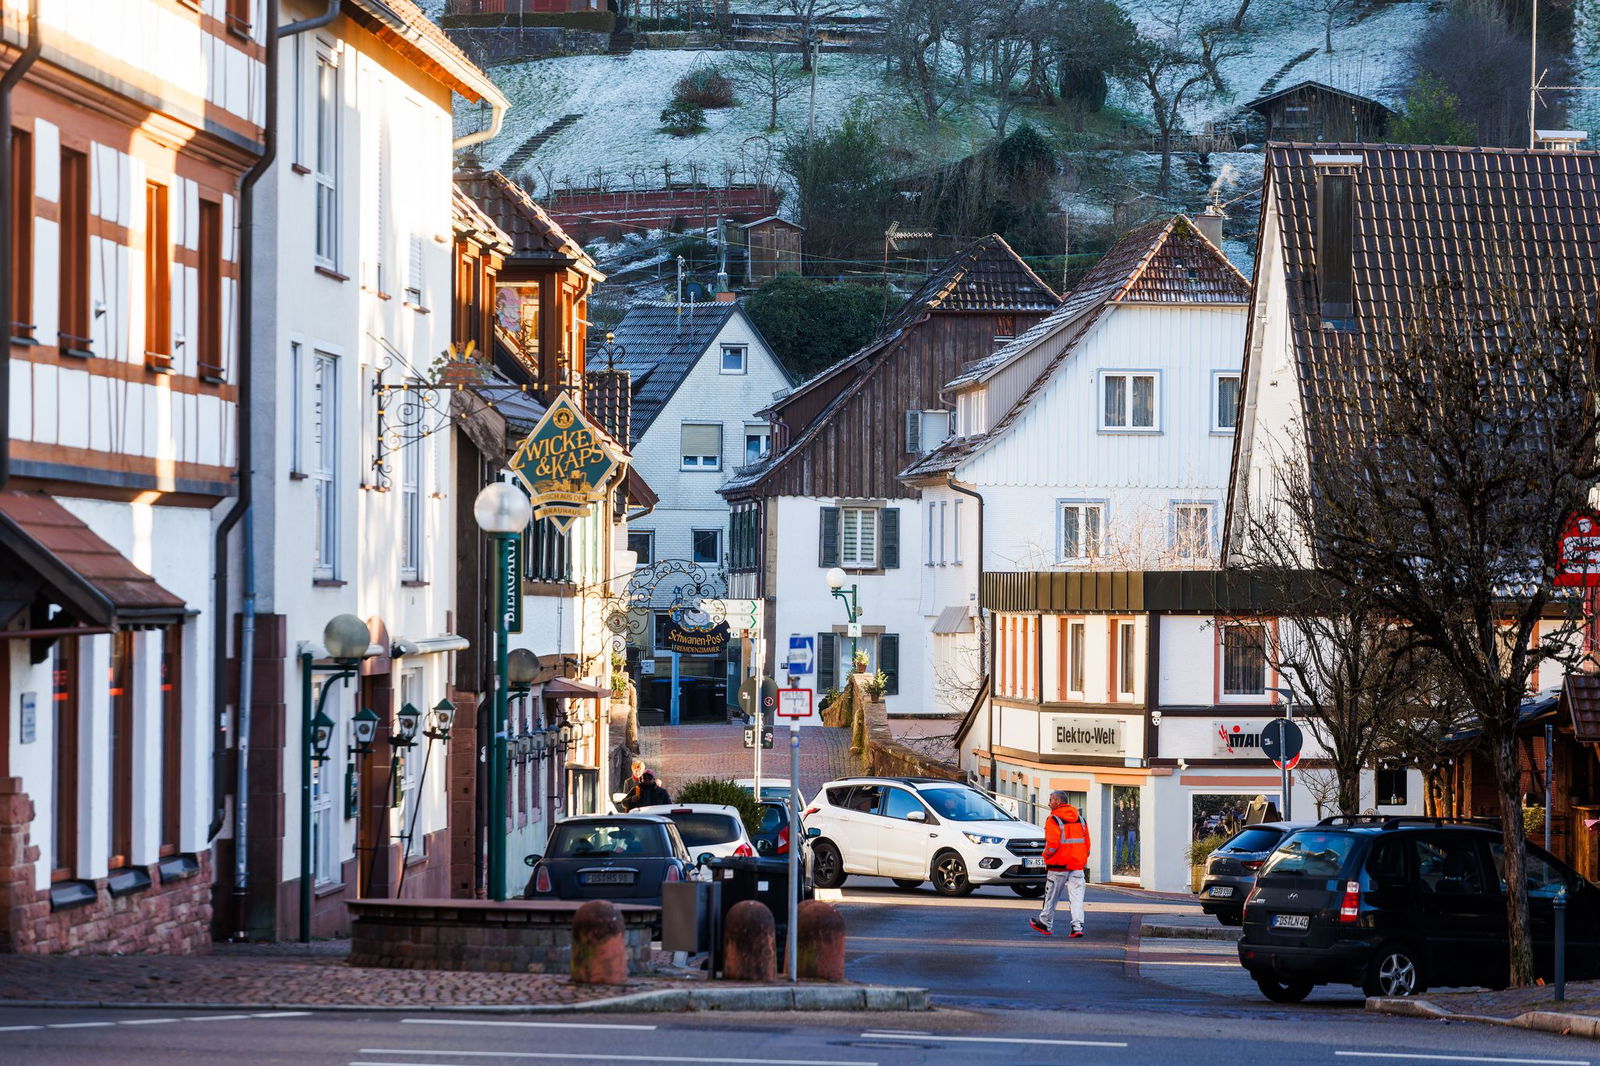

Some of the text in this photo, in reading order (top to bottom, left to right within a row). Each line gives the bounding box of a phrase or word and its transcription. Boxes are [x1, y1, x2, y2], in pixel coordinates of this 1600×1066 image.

[513, 427, 603, 470] ZWICKEL
[536, 439, 604, 480] &KAPS
[1056, 726, 1115, 745] Elektro-Welt
